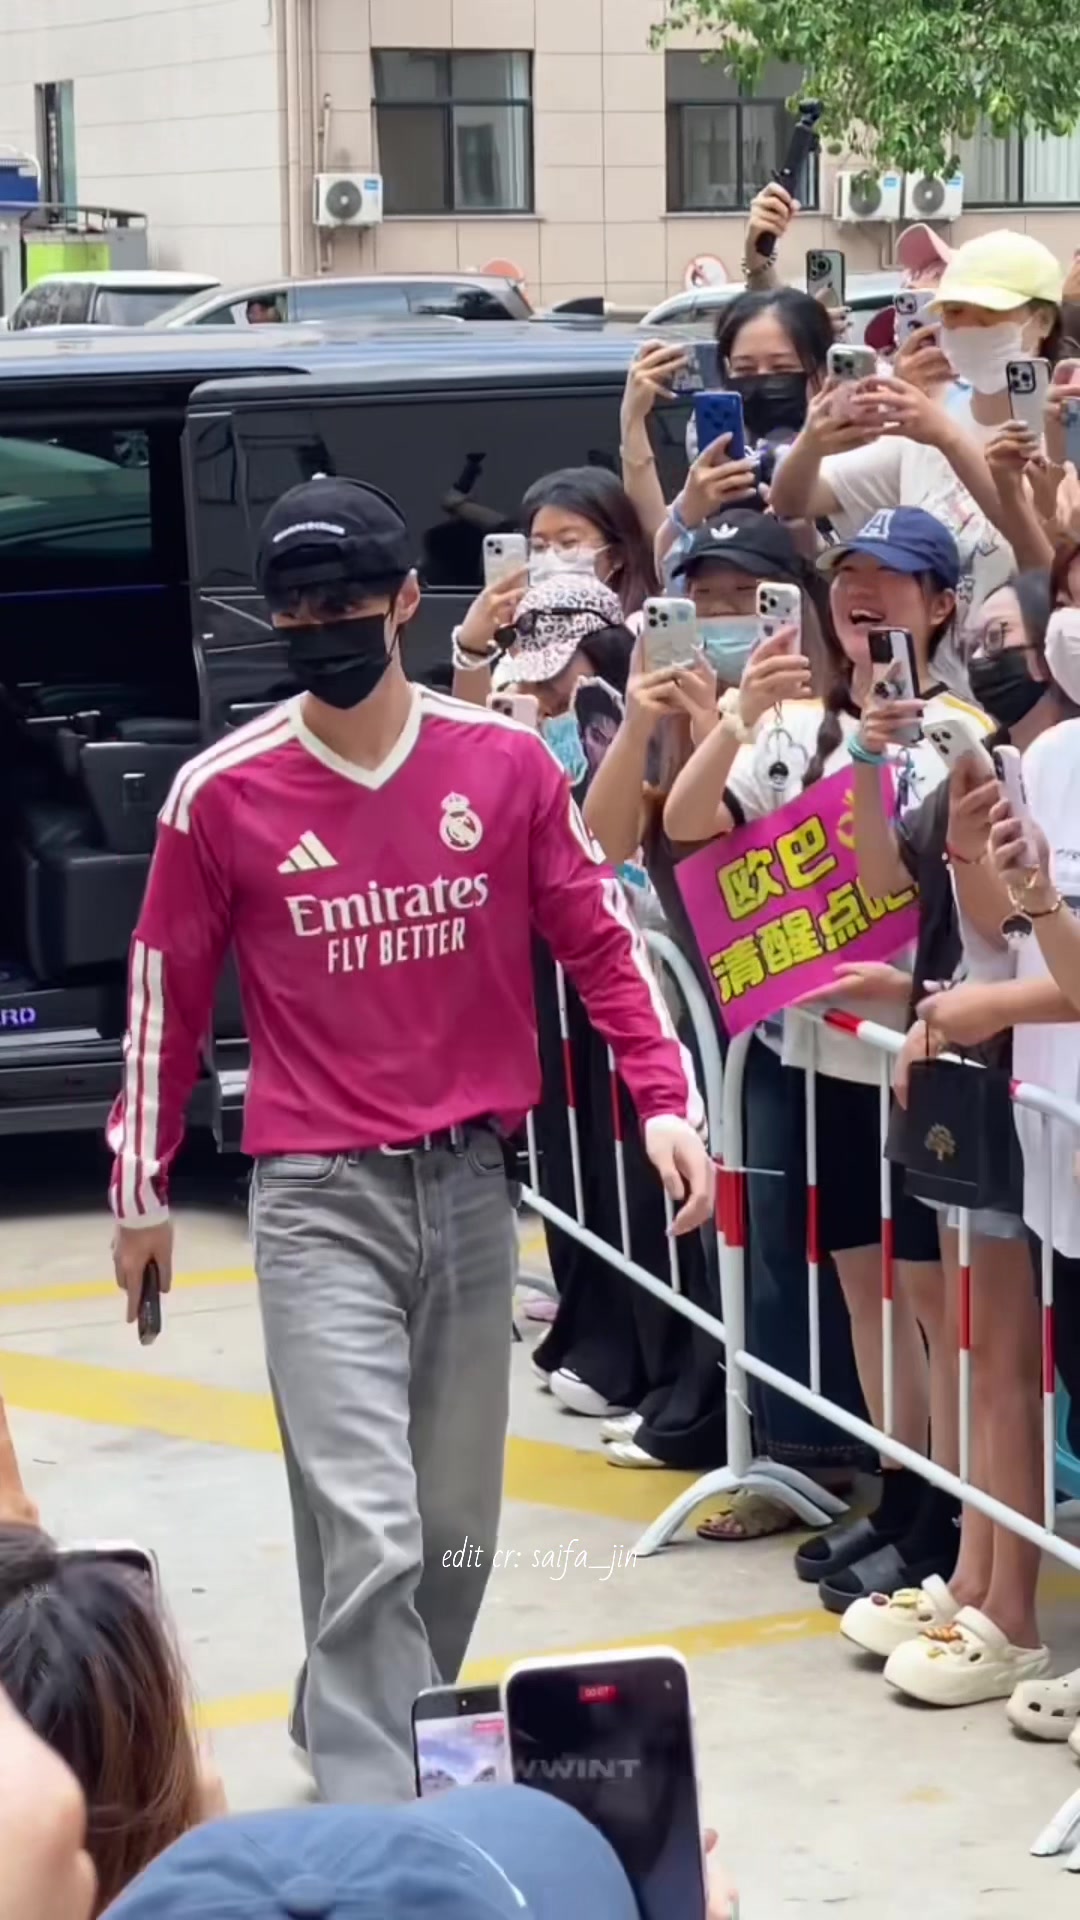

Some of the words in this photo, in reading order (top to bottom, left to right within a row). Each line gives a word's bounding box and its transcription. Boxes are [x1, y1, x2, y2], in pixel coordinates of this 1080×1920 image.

[857, 508, 896, 540] A
[716, 813, 839, 921] 欧巴
[285, 872, 489, 936] Emirates
[328, 934, 368, 973] FLY
[379, 917, 466, 966] BETTER
[0, 1007, 36, 1026] RD
